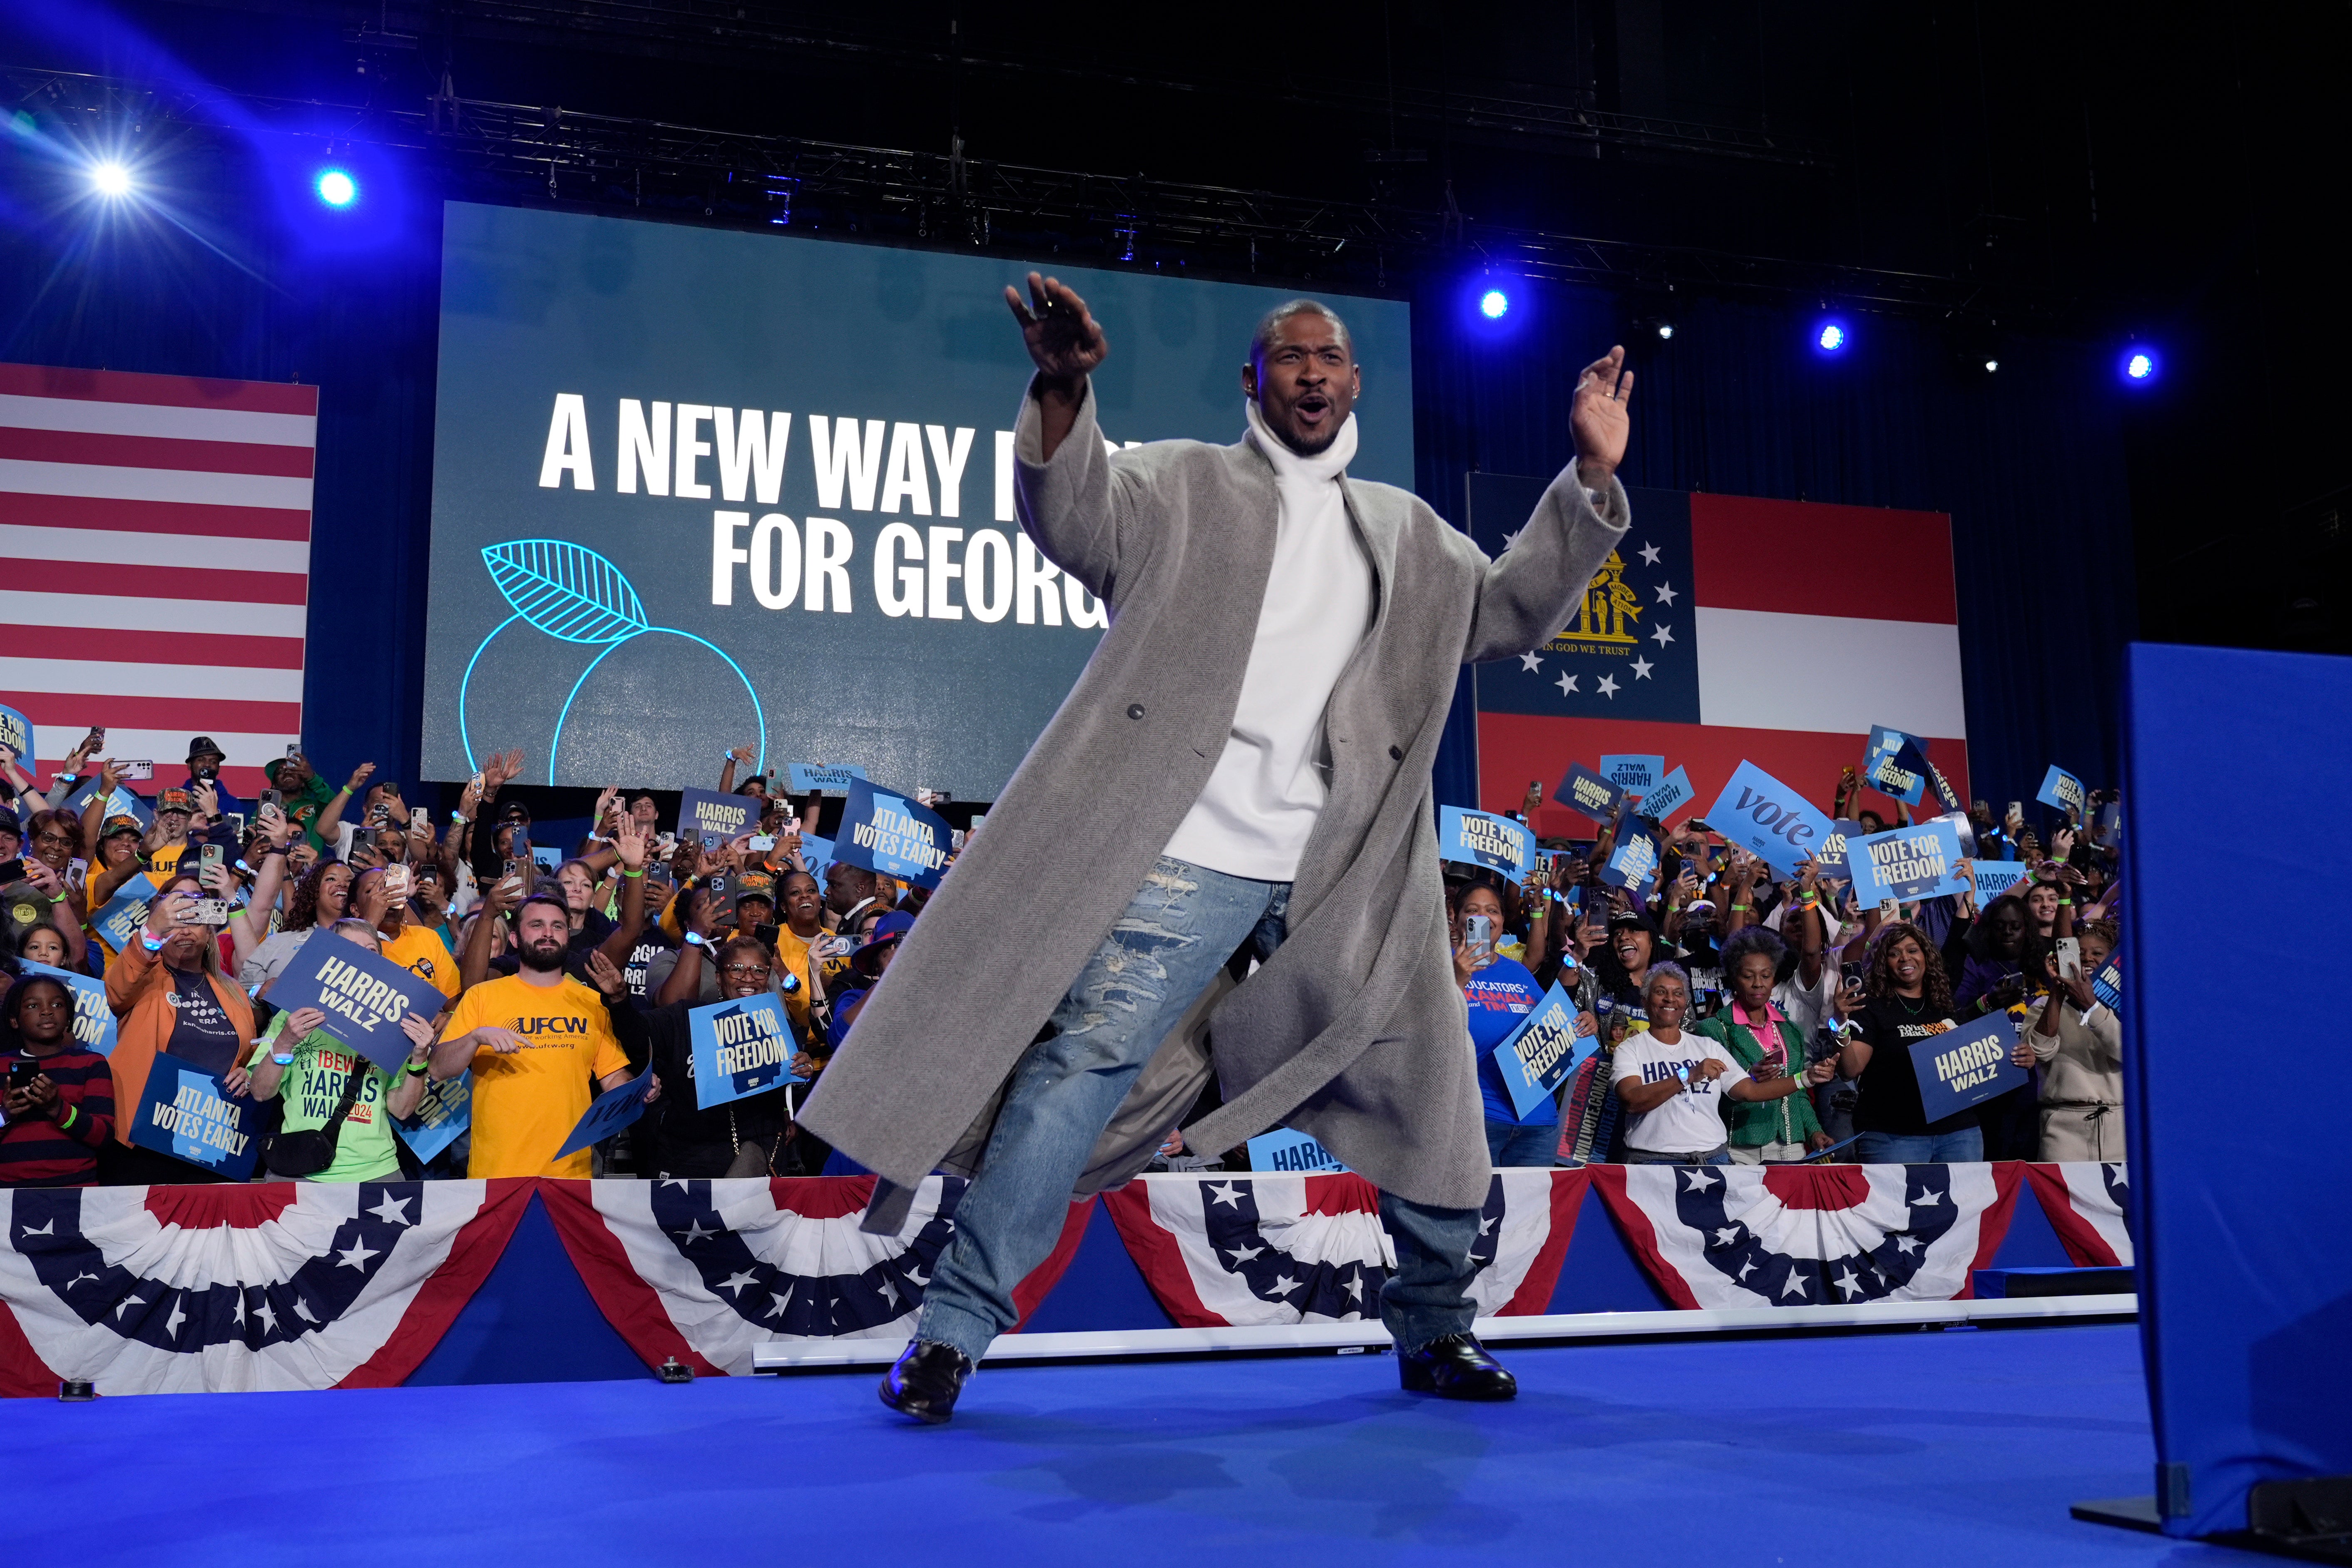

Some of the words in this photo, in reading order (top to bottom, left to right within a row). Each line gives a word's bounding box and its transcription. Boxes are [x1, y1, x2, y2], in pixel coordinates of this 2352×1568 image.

[539, 393, 594, 490] A
[617, 398, 791, 503] NEW
[809, 415, 975, 517] WAY
[712, 510, 853, 613] FOR
[1611, 584, 1633, 599] MODER
[1613, 599, 1633, 613] ATION
[1556, 644, 1578, 653] GOD
[1581, 645, 1596, 654] WE
[1599, 646, 1630, 656] TRUST
[7, 714, 25, 739] FOR
[804, 769, 852, 779] HARRIS
[1611, 772, 1651, 787] HARRIS
[1873, 767, 1914, 791] FREEDOM
[2058, 774, 2077, 793] VOTE
[1573, 775, 1611, 805] HARRIS
[1574, 791, 1601, 810] WALZ
[1642, 785, 1681, 818] HARRIS
[1644, 783, 1671, 805] WALZ
[695, 801, 746, 825] HARRIS
[702, 820, 736, 835] WALZ
[871, 807, 934, 846] ATLANTA
[1735, 785, 1814, 846] vote
[853, 822, 899, 855] VOTES
[900, 838, 946, 870] EARLY
[1461, 815, 1497, 838] VOTE
[1500, 825, 1524, 850] FOR
[1752, 836, 1765, 846] HARRIS
[1460, 831, 1523, 867] FREEDOM
[1618, 833, 1644, 876] ATLANTA
[1624, 860, 1648, 892] VOTES
[1640, 834, 1654, 865] EARLY
[1867, 840, 1908, 865] VOTE
[1909, 835, 1942, 858] FOR
[741, 875, 769, 885] HARRIS
[1872, 855, 1947, 887] FREEDOM
[1974, 873, 2018, 890] HARRIS
[315, 956, 409, 1022] HARRIS
[1463, 989, 1537, 1006] KAMALA
[1717, 978, 1724, 991] &
[75, 989, 110, 1020] FOR
[318, 987, 381, 1032] WALZ
[1482, 1001, 1509, 1012] TIM
[1598, 999, 1613, 1007] HARRIS
[517, 1017, 587, 1034] UFCW
[713, 1013, 753, 1047] VOTE
[752, 1008, 781, 1037] FOR
[1513, 1023, 1546, 1065] VOTE
[1541, 1002, 1568, 1039] FOR
[1899, 1029, 1933, 1037] Black
[318, 1050, 354, 1073] IBEW
[716, 1034, 788, 1077] FREEDOM
[1522, 1021, 1577, 1088] FREEDOM
[1935, 1035, 2004, 1081] HARRIS
[1951, 1063, 1998, 1093] WALZ
[173, 1085, 241, 1130] ATLANTA
[432, 1079, 469, 1112] FOR
[152, 1101, 202, 1139] VOTES
[201, 1121, 249, 1156] EARLY
[1272, 1140, 1339, 1171] HARR
